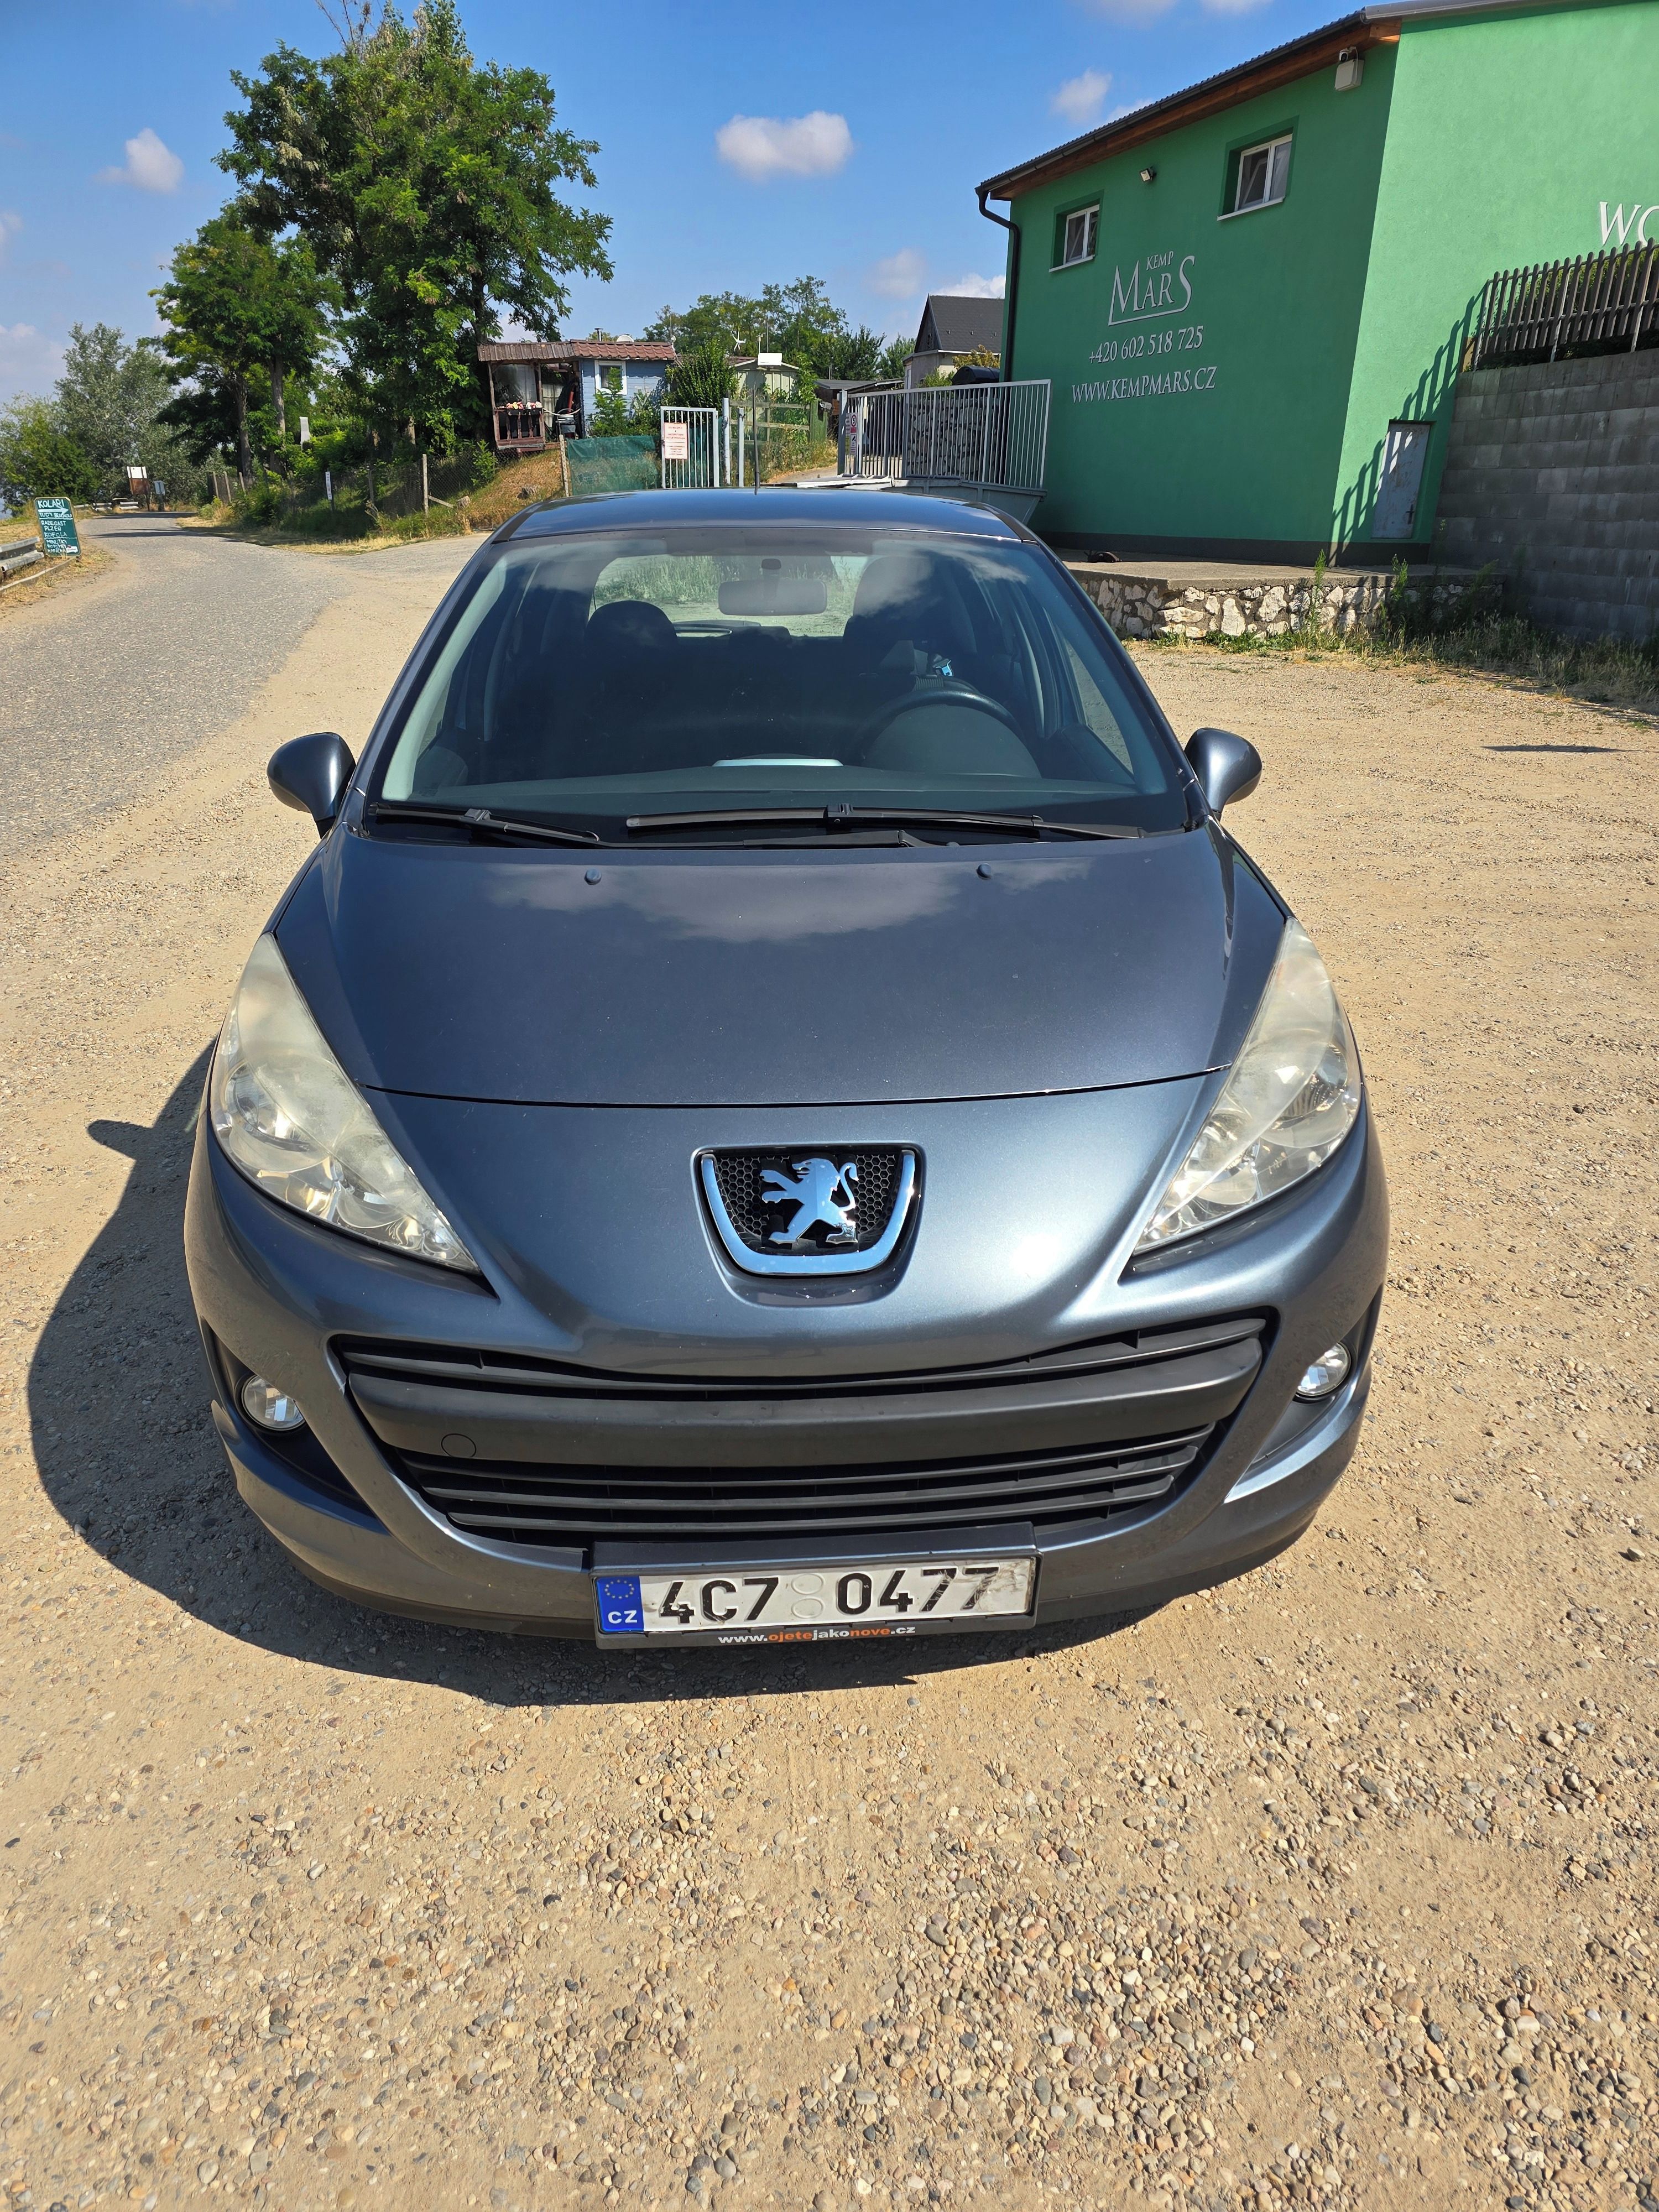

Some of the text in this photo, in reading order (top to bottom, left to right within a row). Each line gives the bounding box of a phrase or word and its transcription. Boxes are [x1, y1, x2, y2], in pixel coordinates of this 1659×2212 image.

[1146, 251, 1174, 270] KEMP
[1089, 325, 1204, 363] +420 602 518 725
[1072, 366, 1217, 403] WWW.KEMPMARS.CZ
[660, 1567, 1000, 1624] 4C7 0477
[608, 1610, 638, 1624] CZ
[718, 1626, 916, 1644] www.ojetejakonove.cz
